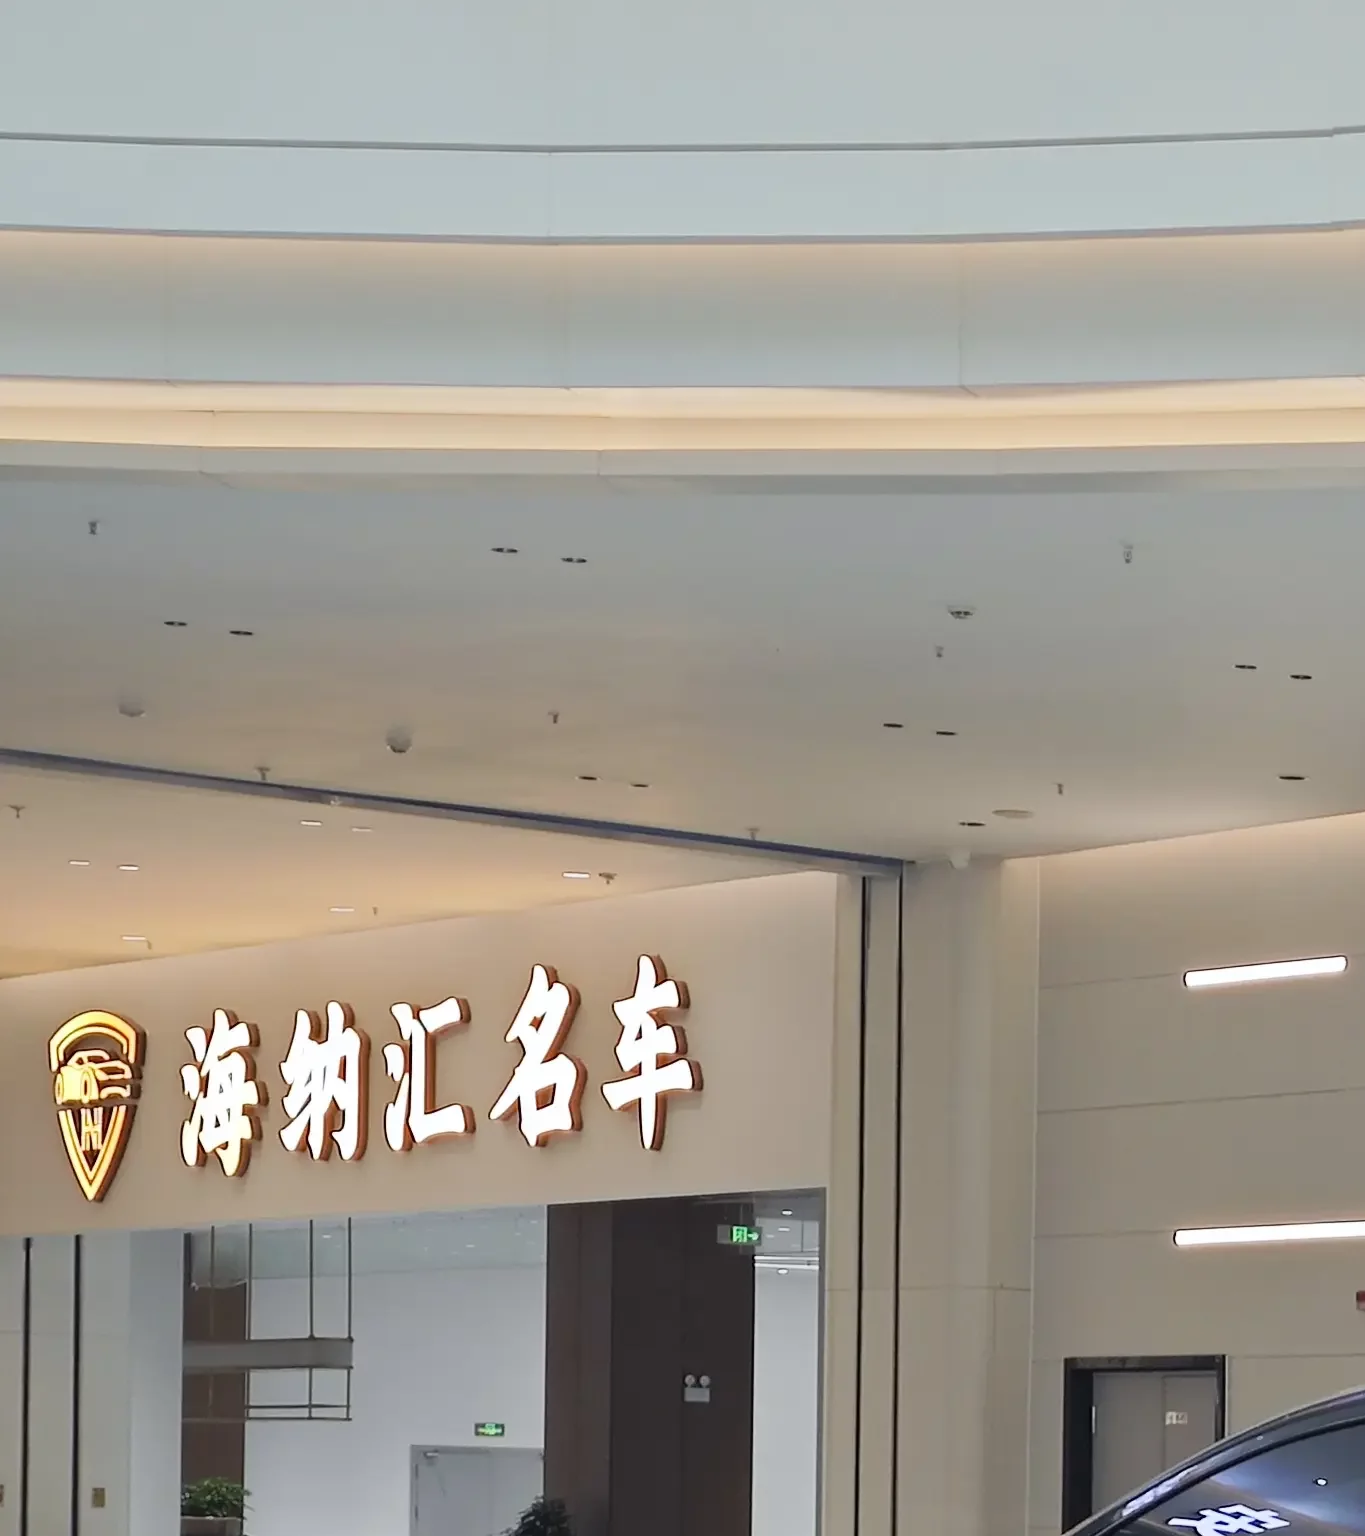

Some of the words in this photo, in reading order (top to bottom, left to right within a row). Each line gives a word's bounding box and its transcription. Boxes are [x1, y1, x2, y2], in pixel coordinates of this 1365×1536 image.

[179, 954, 702, 1176] 海纳汇名车
